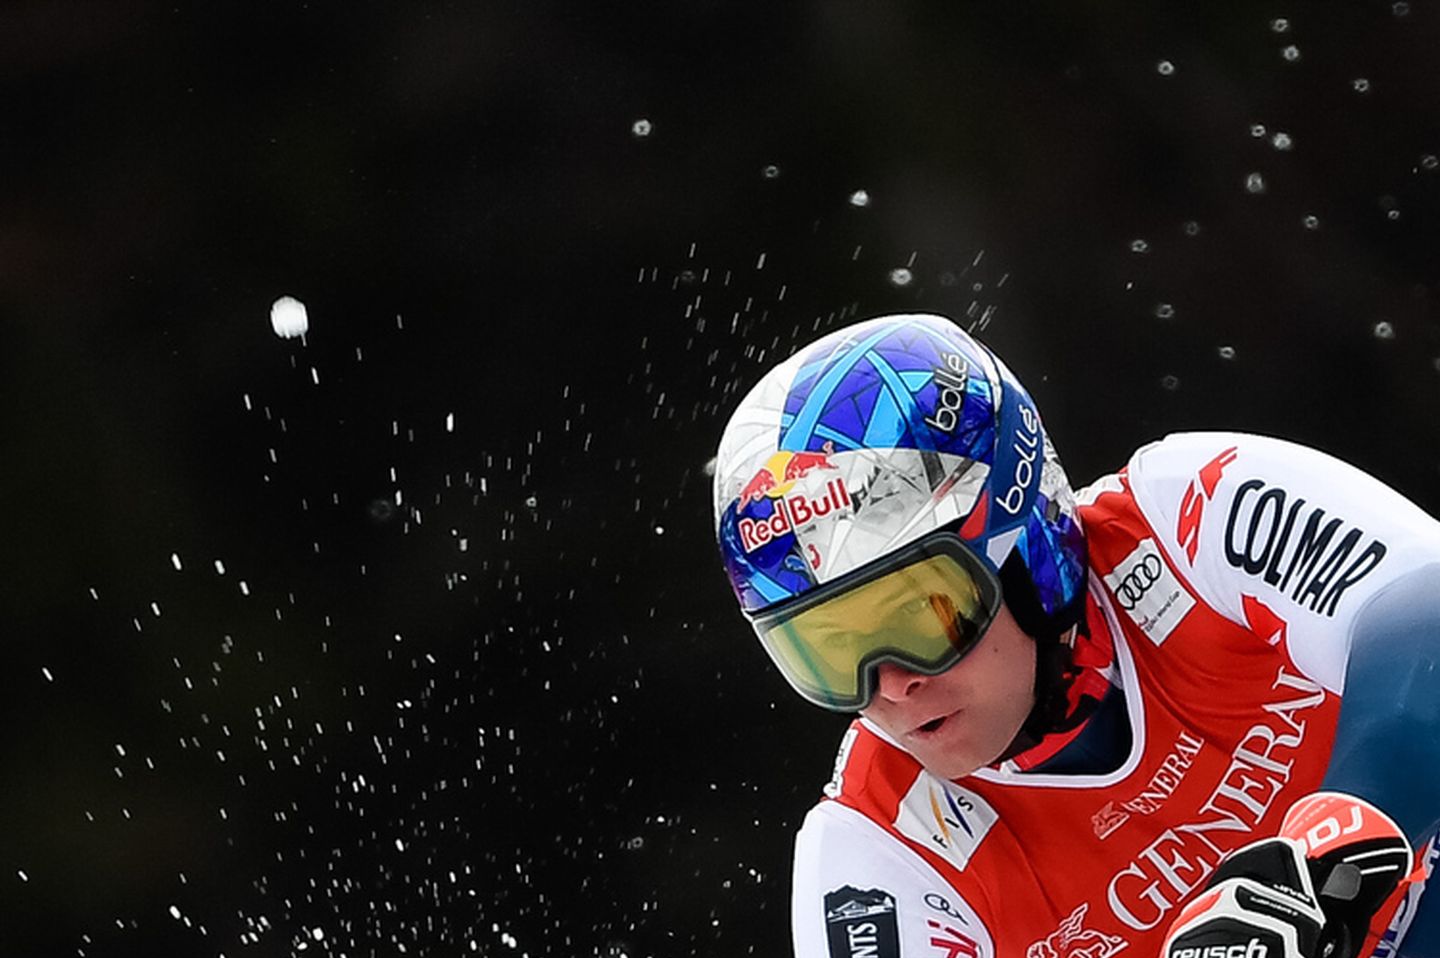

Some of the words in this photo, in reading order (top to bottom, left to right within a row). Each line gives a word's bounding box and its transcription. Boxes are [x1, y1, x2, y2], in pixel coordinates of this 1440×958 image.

[738, 512, 790, 552] Red
[790, 479, 852, 528] Bull
[1224, 479, 1388, 617] COLMAR
[932, 795, 974, 849] FIS
